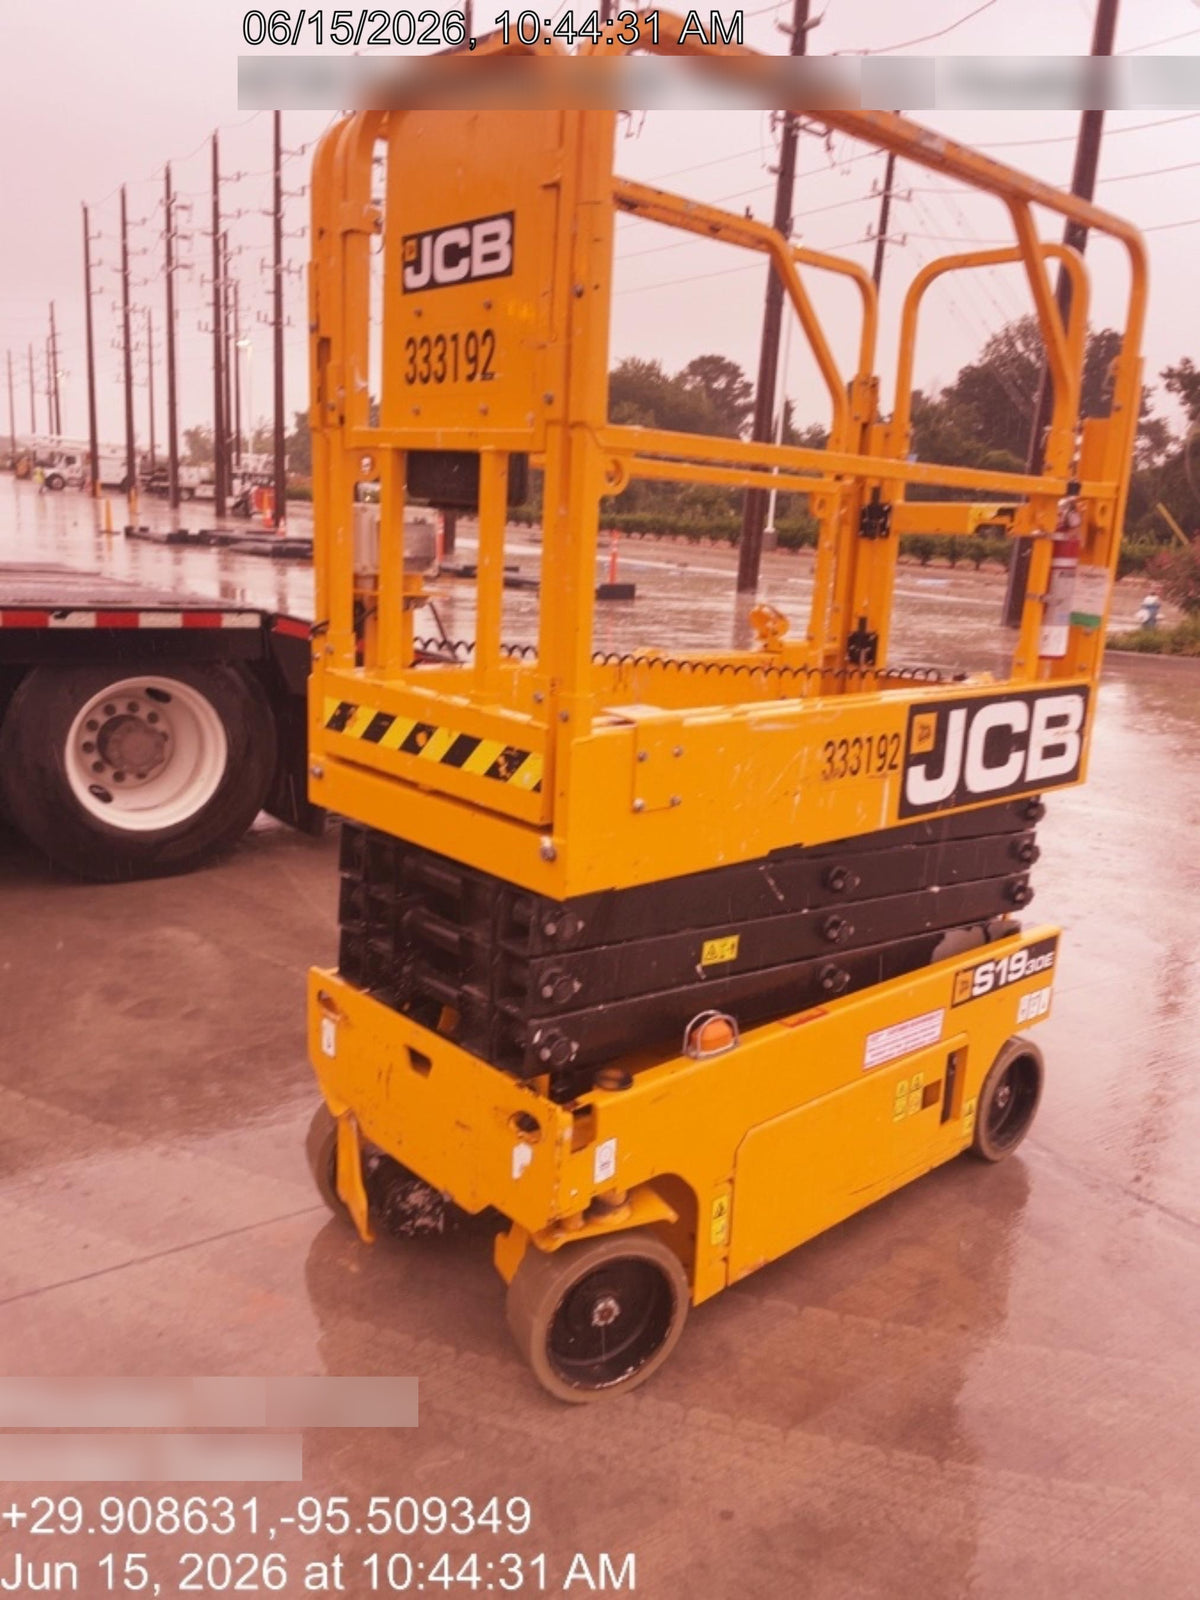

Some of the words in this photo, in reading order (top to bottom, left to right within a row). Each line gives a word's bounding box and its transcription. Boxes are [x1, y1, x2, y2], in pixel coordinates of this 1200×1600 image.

[403, 217, 512, 290] JCB
[404, 328, 496, 386] 333192
[821, 732, 901, 781] 333192
[905, 694, 1084, 806] JCB
